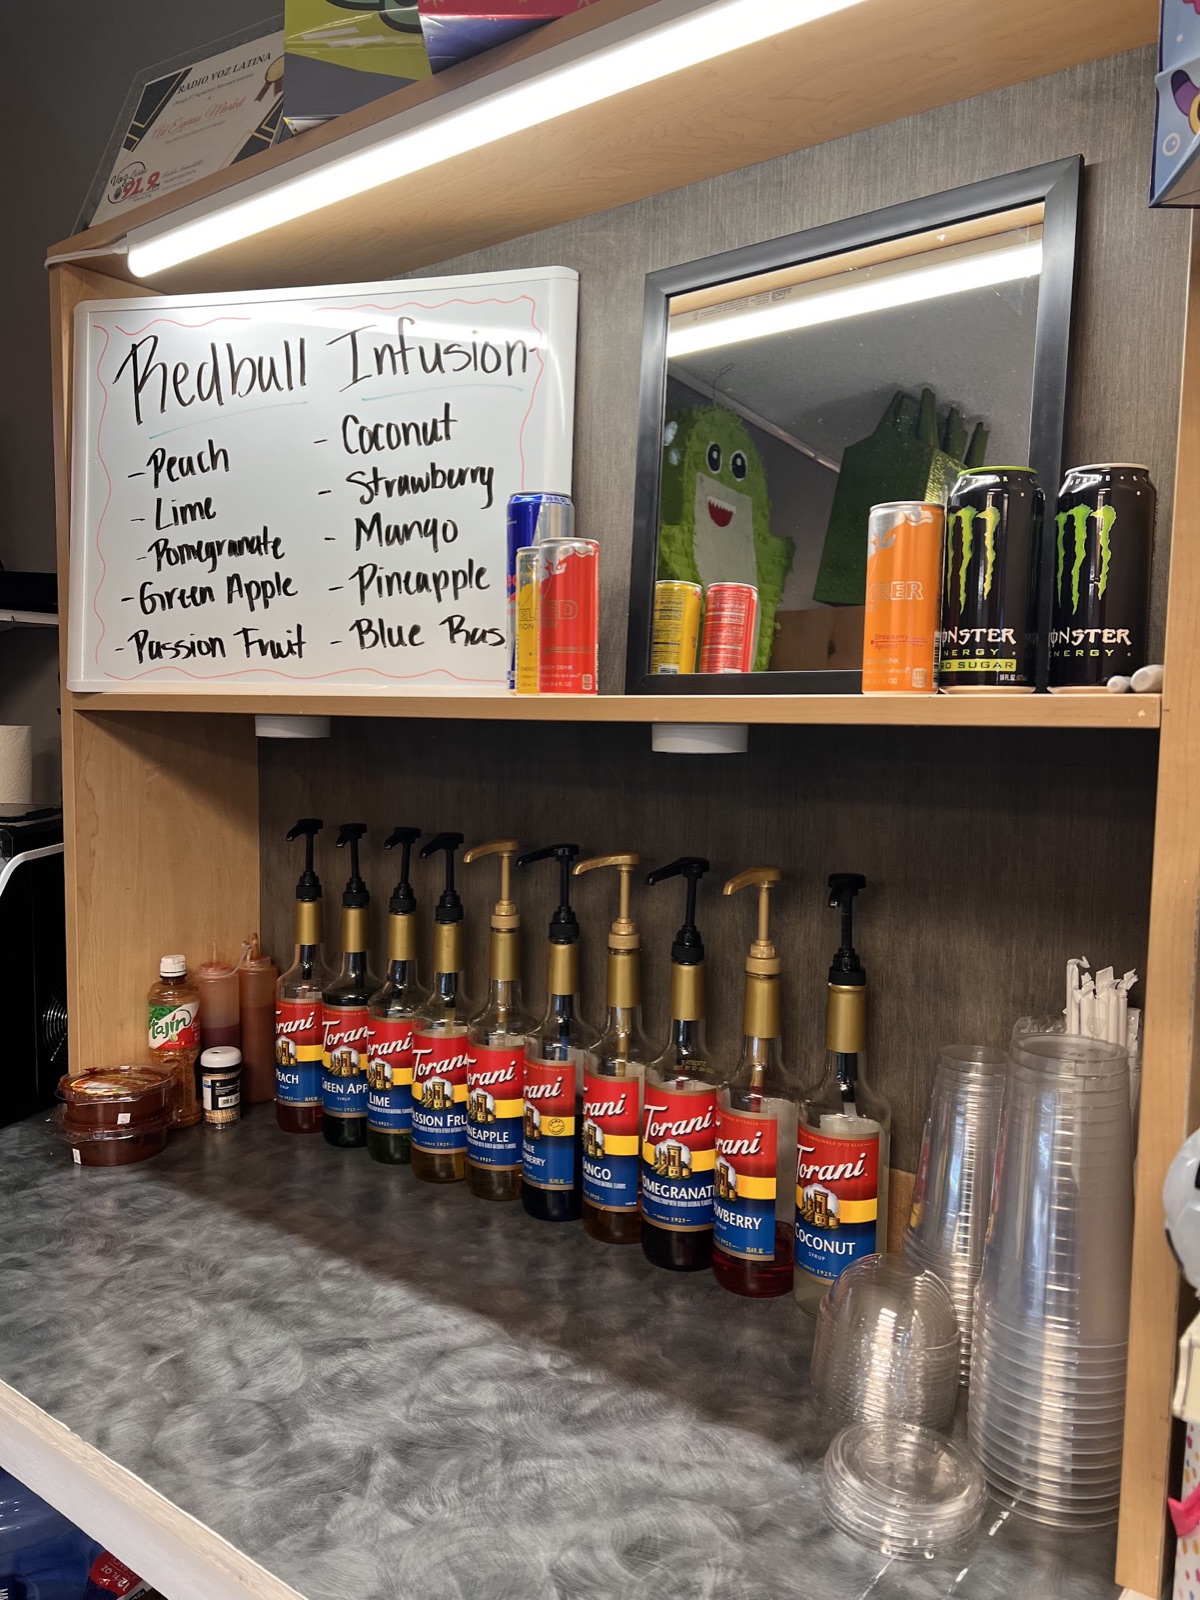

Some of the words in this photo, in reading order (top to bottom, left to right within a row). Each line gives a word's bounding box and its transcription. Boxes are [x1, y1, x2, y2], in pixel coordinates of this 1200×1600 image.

[177, 76, 209, 95] RADIO
[211, 67, 231, 81] VOZ
[232, 52, 272, 74] LATINA
[112, 335, 306, 425] Redbull
[341, 403, 458, 454] Coconut
[146, 439, 230, 488] Peach
[345, 463, 494, 510] Strawberry
[155, 497, 217, 530] Lime
[353, 512, 459, 553] Mango
[139, 581, 216, 615] Green
[226, 571, 298, 612] Apple
[348, 559, 491, 606] Pineapple
[127, 629, 227, 664] Passion
[233, 622, 307, 660] Fruit
[348, 617, 425, 649] Blue
[941, 626, 1017, 647] ONSTER
[1049, 626, 1132, 647] ONSTER
[943, 648, 1000, 656] NERGY
[957, 661, 1014, 670] SUGAR
[321, 1020, 368, 1052] Toran
[412, 1048, 468, 1082] Toran
[369, 1091, 391, 1108] LIME
[523, 1076, 563, 1099] rani
[412, 1108, 443, 1127] ASSION
[446, 1114, 468, 1127] FRU
[583, 1093, 627, 1117] rani
[467, 1124, 510, 1143] NEAPPLE
[644, 1104, 714, 1144] Torani
[714, 1131, 763, 1156] rani
[583, 1160, 612, 1181] ANGO
[797, 1143, 866, 1182] Torani
[641, 1174, 715, 1200] OMEGRANAT
[795, 1222, 856, 1256] COCONUT
[808, 1251, 826, 1262] SYRUP
[816, 1268, 832, 1277] 1925
[100, 1564, 113, 1575] OZ
[117, 1576, 130, 1592] 12
